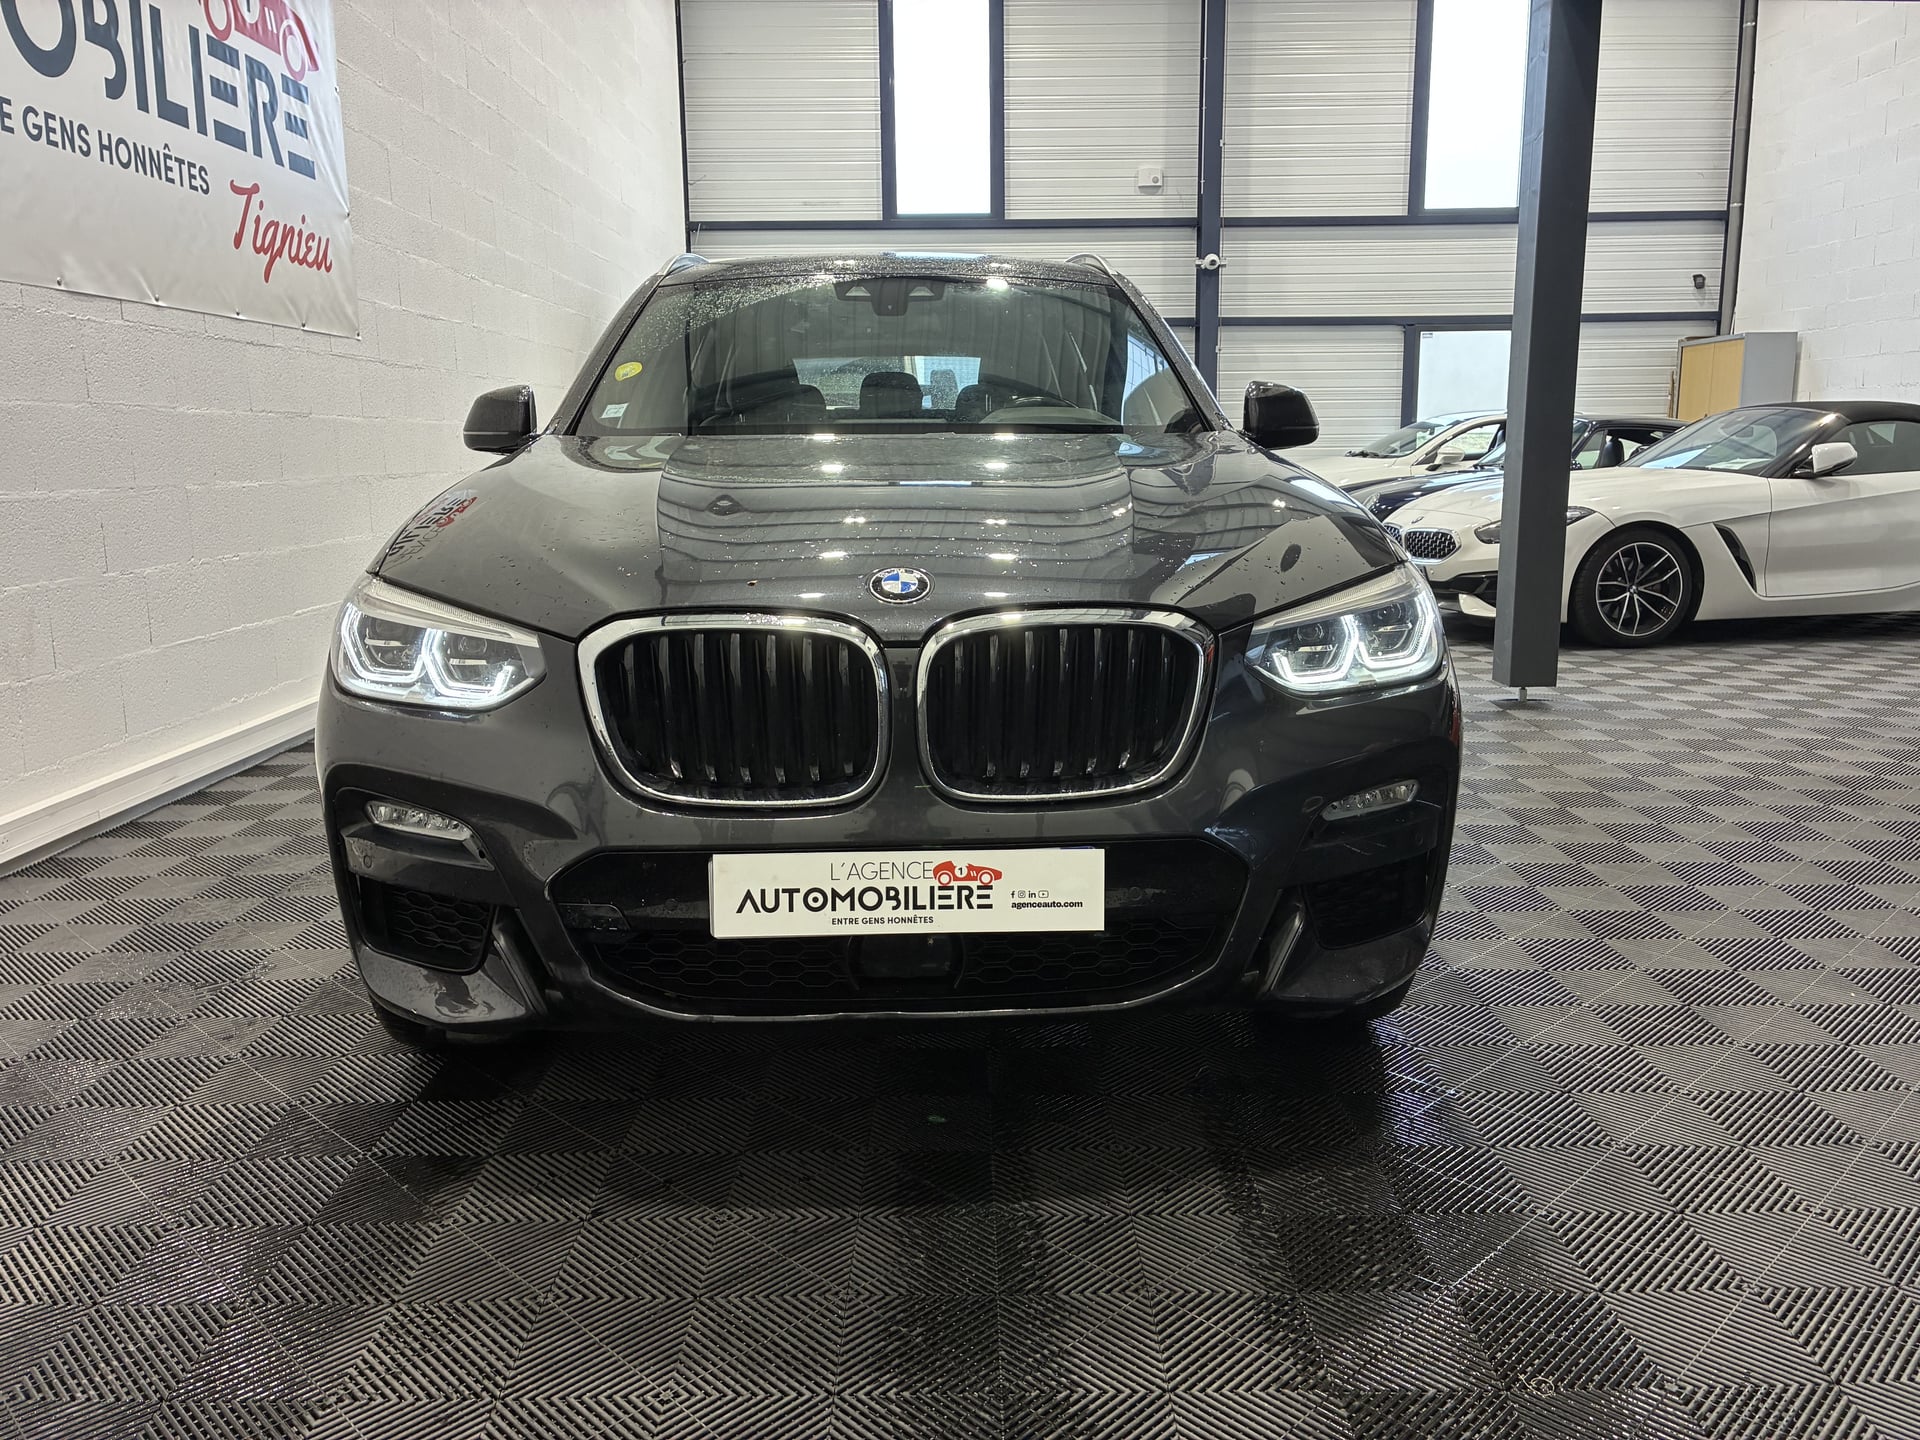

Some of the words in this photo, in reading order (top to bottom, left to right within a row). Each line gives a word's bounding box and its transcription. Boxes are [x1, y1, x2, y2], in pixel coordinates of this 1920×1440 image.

[22, 105, 91, 157] GENS
[97, 129, 210, 195] HONNÊTES
[229, 179, 333, 284] Tignieu
[830, 861, 933, 881] L'AGENCE
[1011, 901, 1083, 910] agenceauto.com
[831, 917, 860, 925] ENTRE
[861, 916, 885, 925] GENS
[887, 914, 934, 924] HONNÊTES
